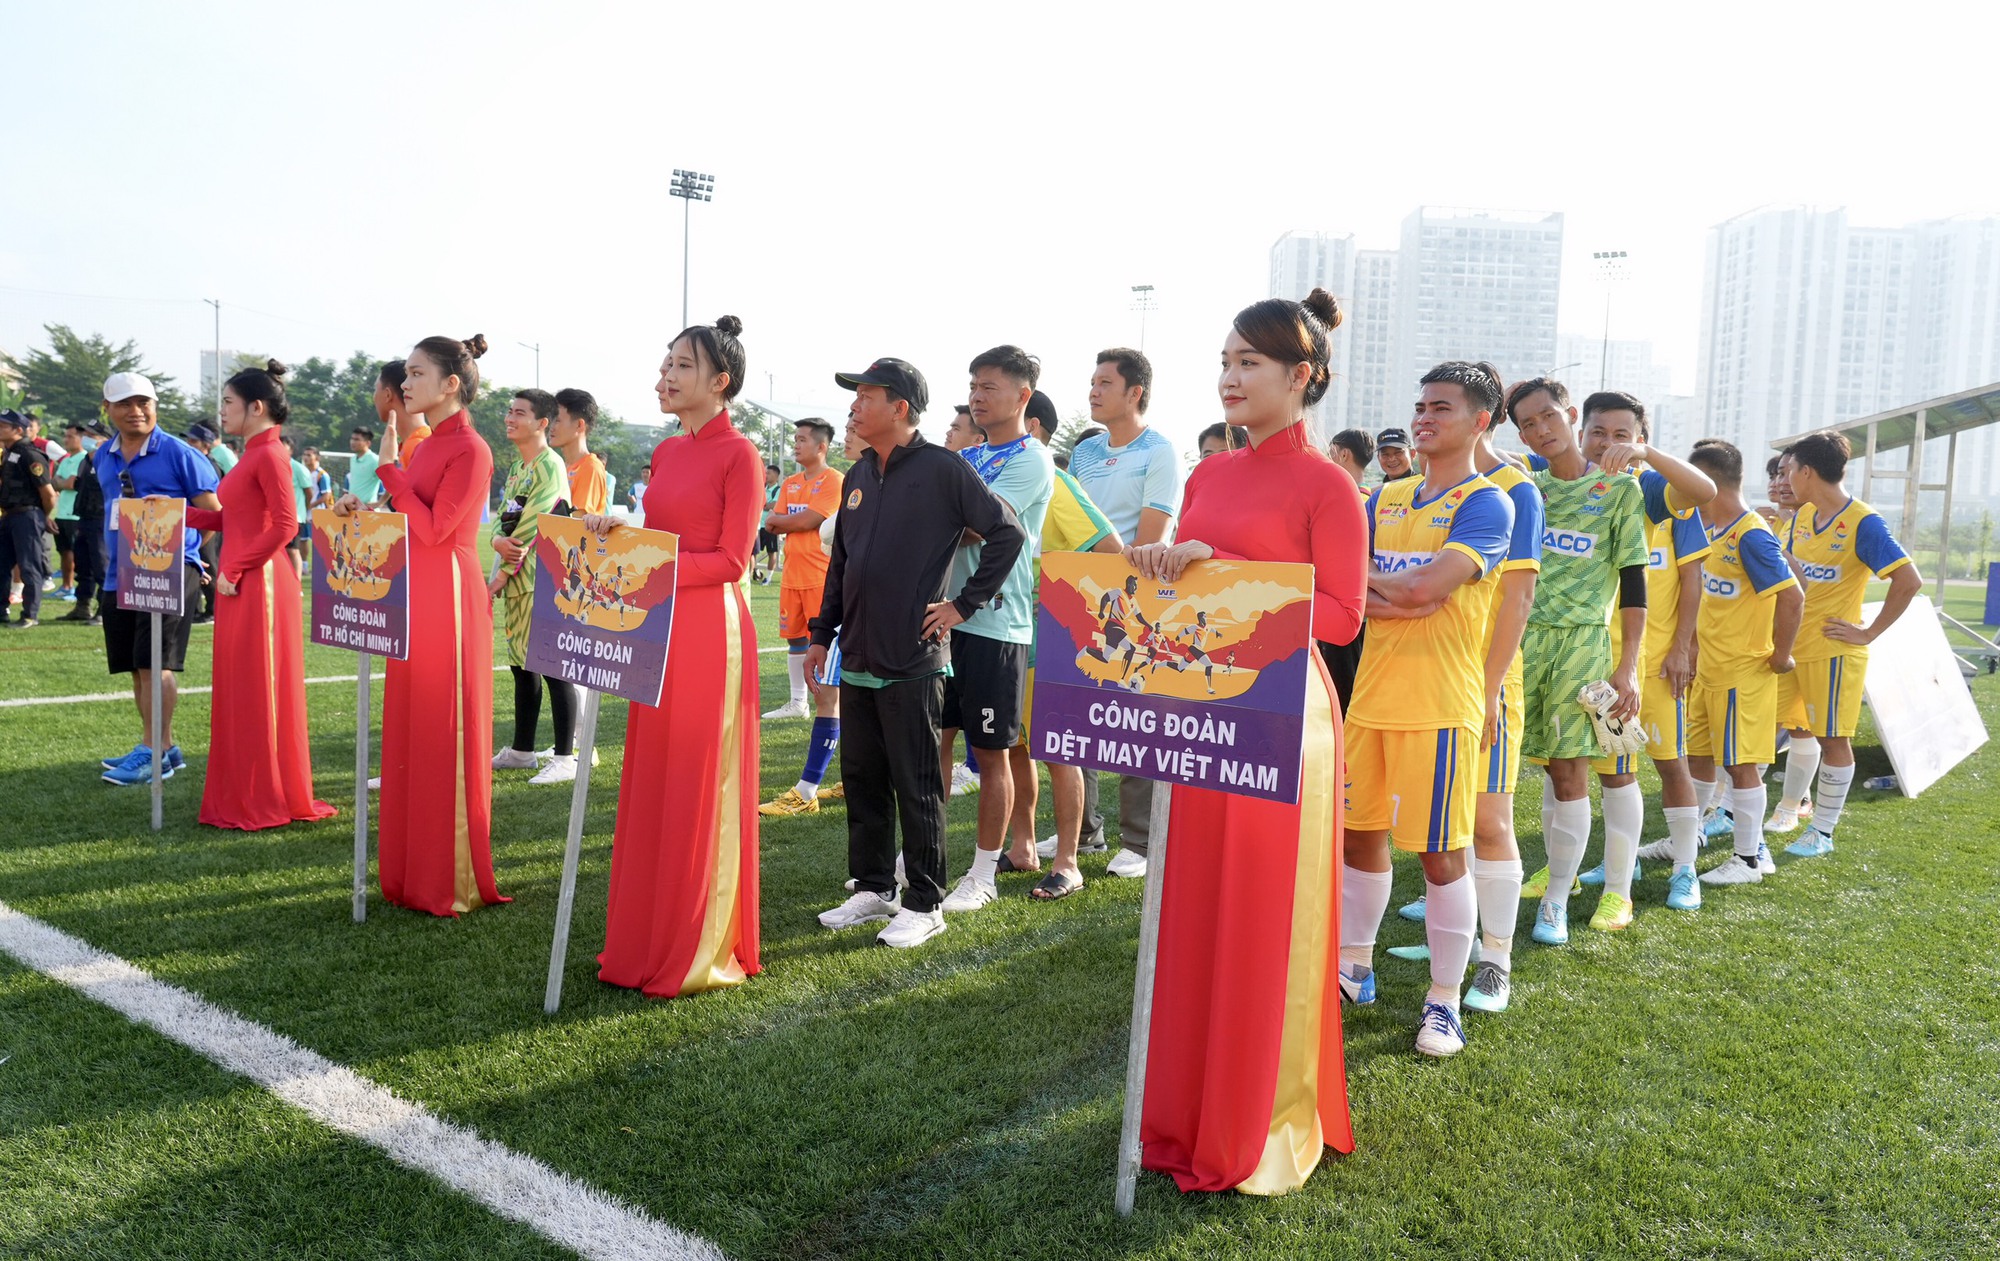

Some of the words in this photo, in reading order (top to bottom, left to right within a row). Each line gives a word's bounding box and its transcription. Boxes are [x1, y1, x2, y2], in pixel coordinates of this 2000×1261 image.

[1542, 531, 1592, 553] ACO
[1373, 554, 1433, 573] THA
[1802, 564, 1836, 580] ACO
[134, 573, 150, 589] CÔNG
[151, 575, 169, 591] ĐOÀN
[124, 590, 134, 605] BÀ
[146, 592, 164, 609] VŨNG
[165, 595, 177, 611] TÀU
[333, 602, 357, 623] CÔNG
[359, 607, 386, 628] ĐOÀN
[320, 624, 333, 641] TP.
[334, 624, 348, 643] HỒ
[349, 628, 366, 647] CHÍ
[366, 633, 392, 653] MINH
[394, 638, 399, 654] 1
[557, 630, 592, 656] CÔNG
[594, 640, 633, 664] ĐOÀN
[561, 658, 585, 681] TÂY
[587, 666, 621, 690] NINH
[981, 707, 995, 733] 2
[1088, 700, 1157, 734] CÔNG
[1163, 712, 1237, 746] ĐOÀN
[1045, 729, 1091, 761] DỆT
[1097, 739, 1149, 768] MAY
[1155, 747, 1212, 781] VIỆT
[1219, 759, 1279, 792] NAM
[1392, 793, 1401, 827] 7
